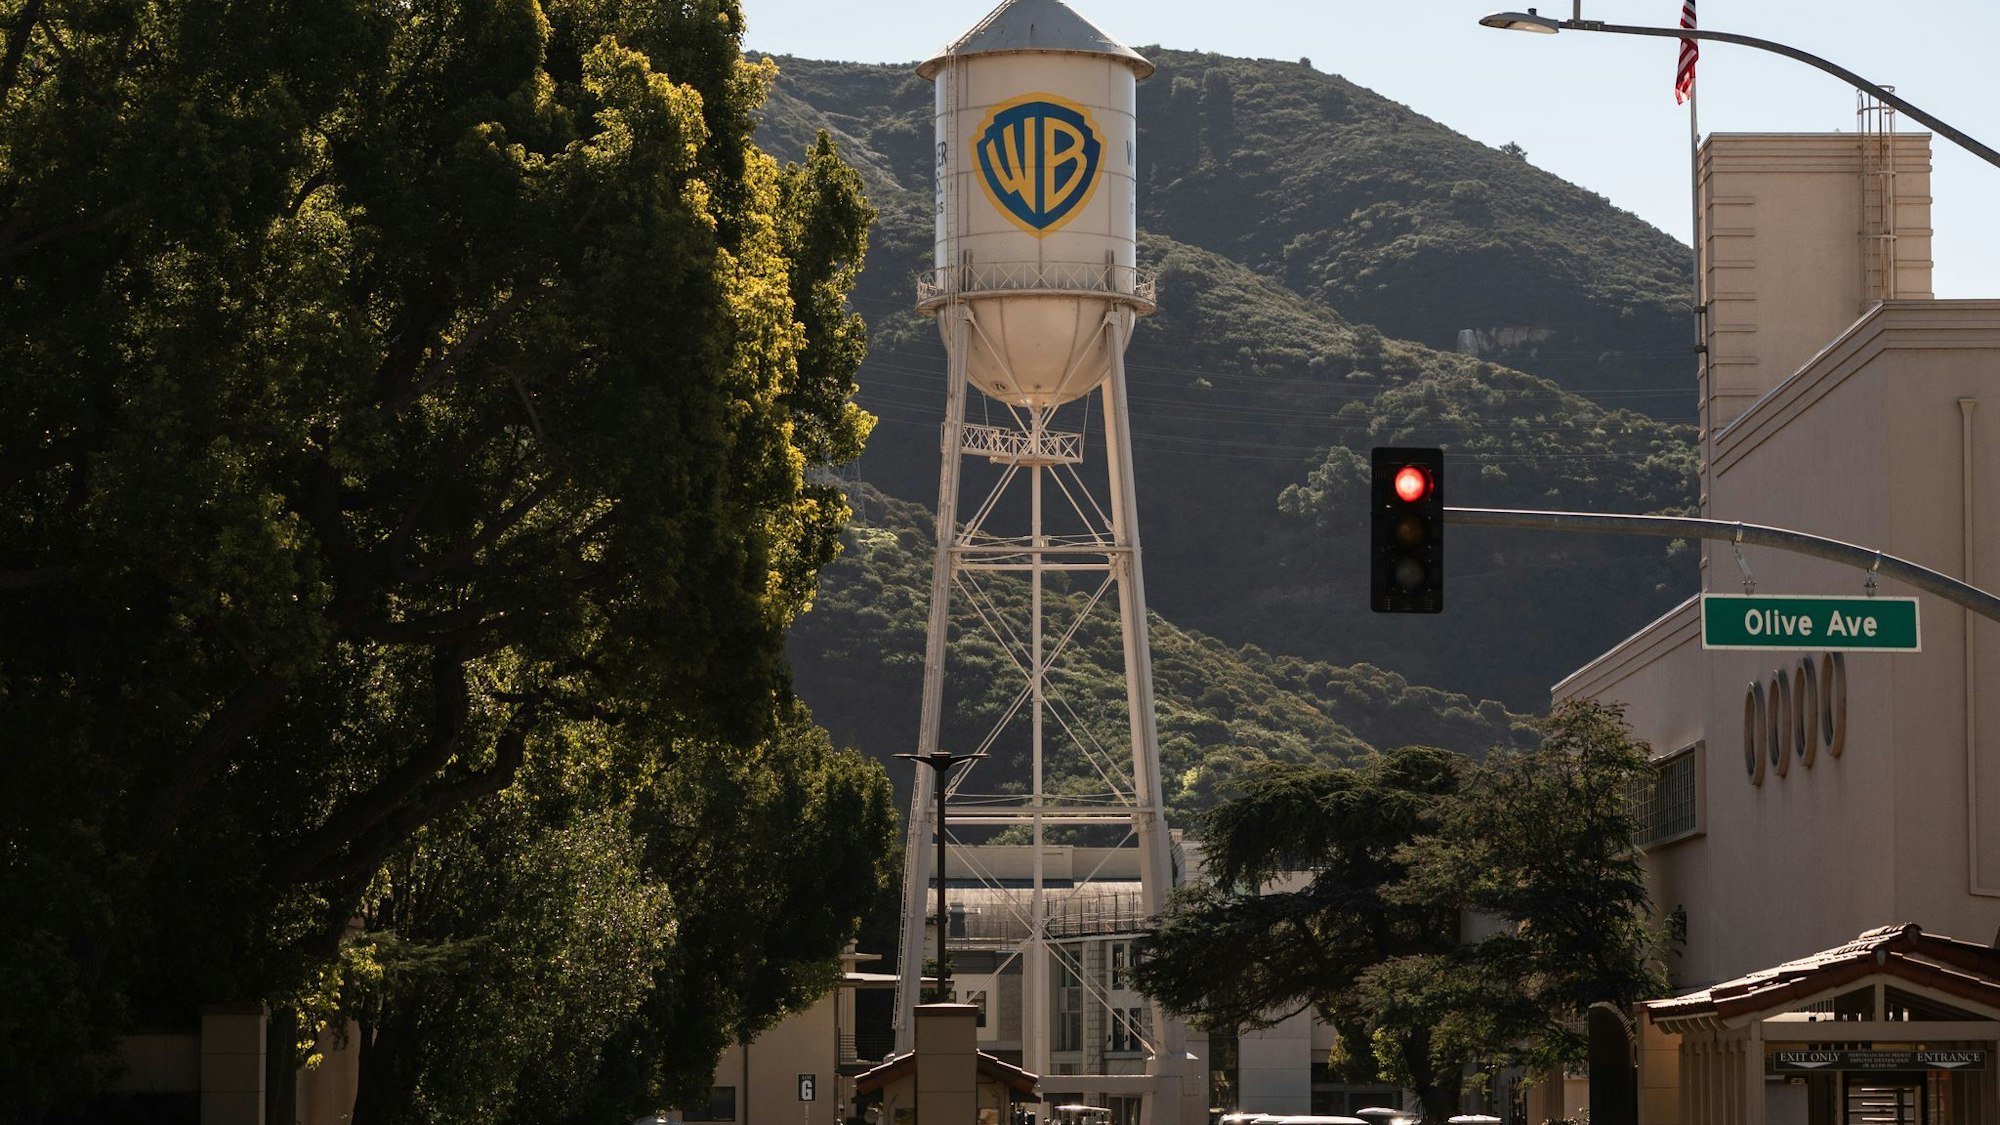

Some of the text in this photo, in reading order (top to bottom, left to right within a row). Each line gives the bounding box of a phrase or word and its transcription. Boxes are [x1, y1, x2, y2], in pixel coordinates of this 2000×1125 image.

[986, 117, 1088, 214] WB
[1744, 608, 1878, 638] Olive Ave
[1780, 1052, 1807, 1062] EXIT
[1810, 1052, 1840, 1062] ONLY
[1917, 1052, 1981, 1062] ENTRANCE
[801, 1080, 813, 1101] G
